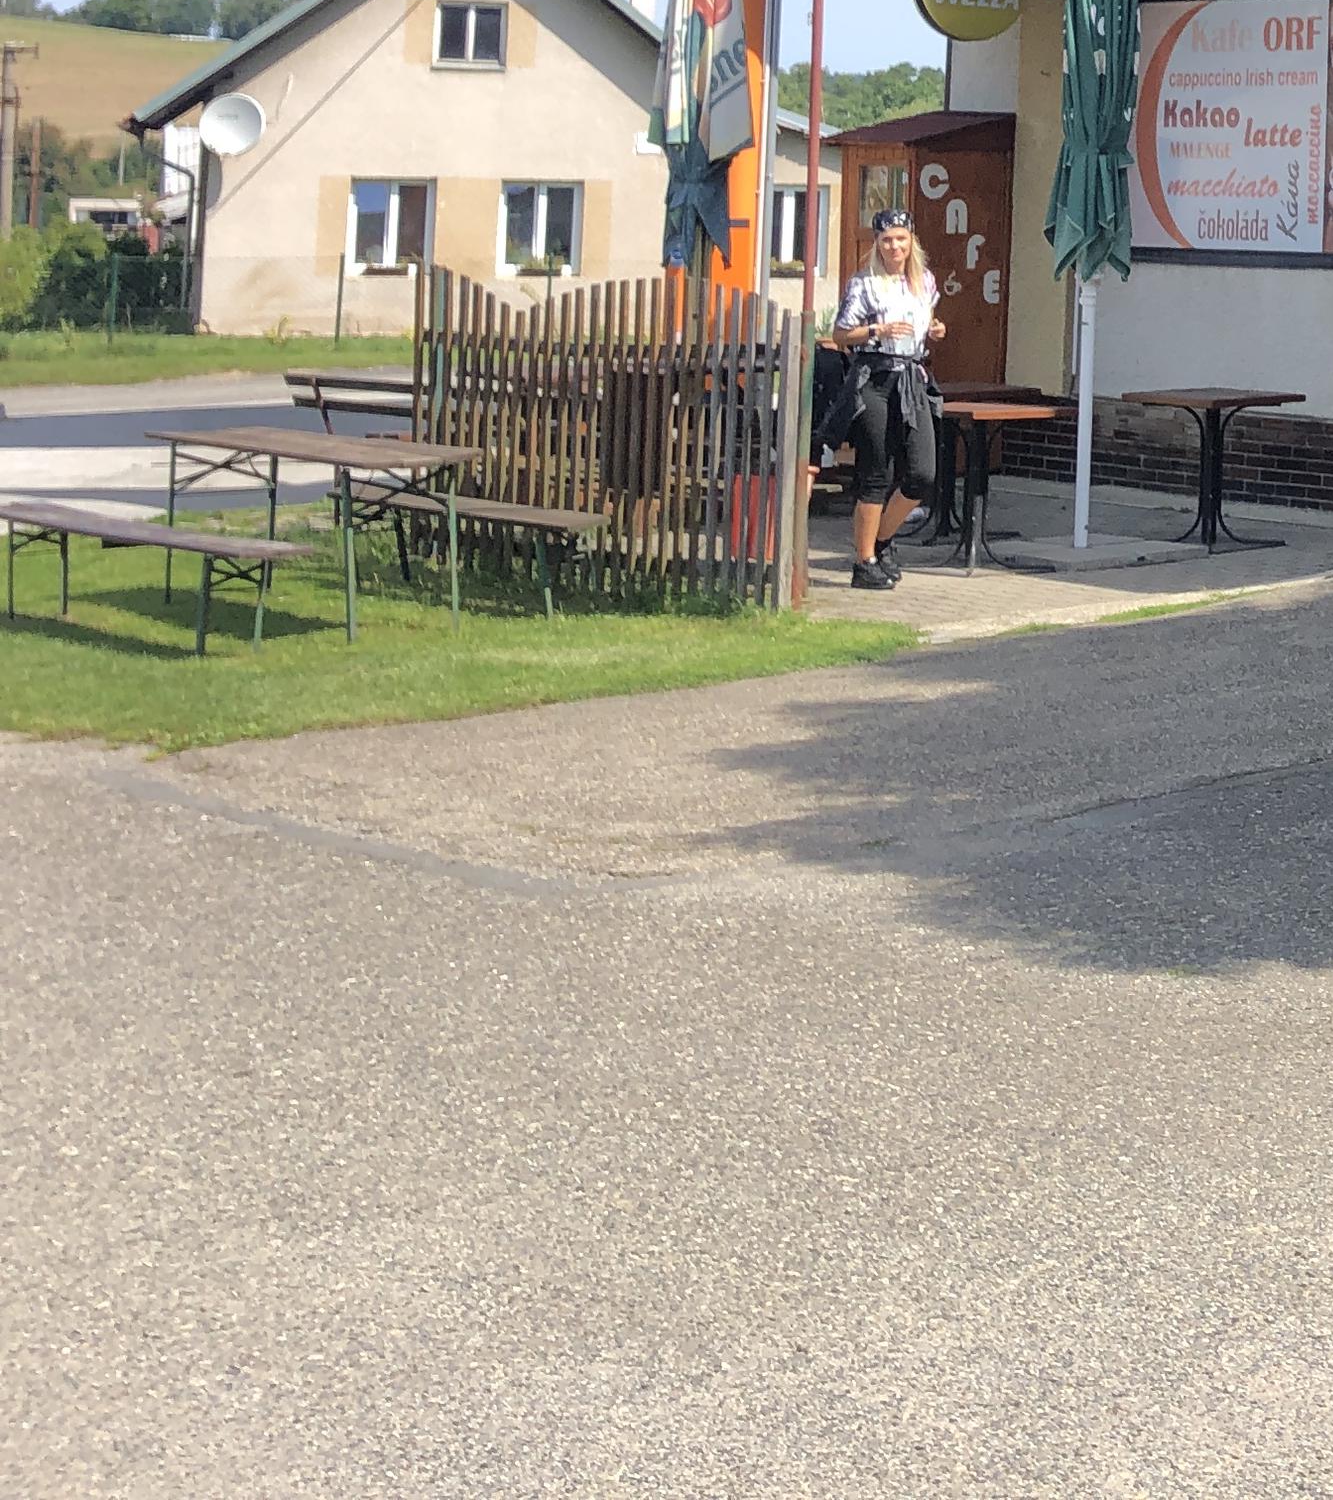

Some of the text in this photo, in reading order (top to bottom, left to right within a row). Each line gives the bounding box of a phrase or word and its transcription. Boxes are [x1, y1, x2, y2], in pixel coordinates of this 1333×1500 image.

[1263, 15, 1324, 52] ORF
[1169, 67, 1319, 91] cappuccino Irish cream
[1162, 99, 1241, 129] Kakao
[1243, 117, 1303, 148] latte
[1306, 102, 1323, 225] moccaccino
[1167, 167, 1280, 198] macchiato
[1275, 159, 1301, 241] Káva
[1197, 209, 1269, 241] čokoláda
